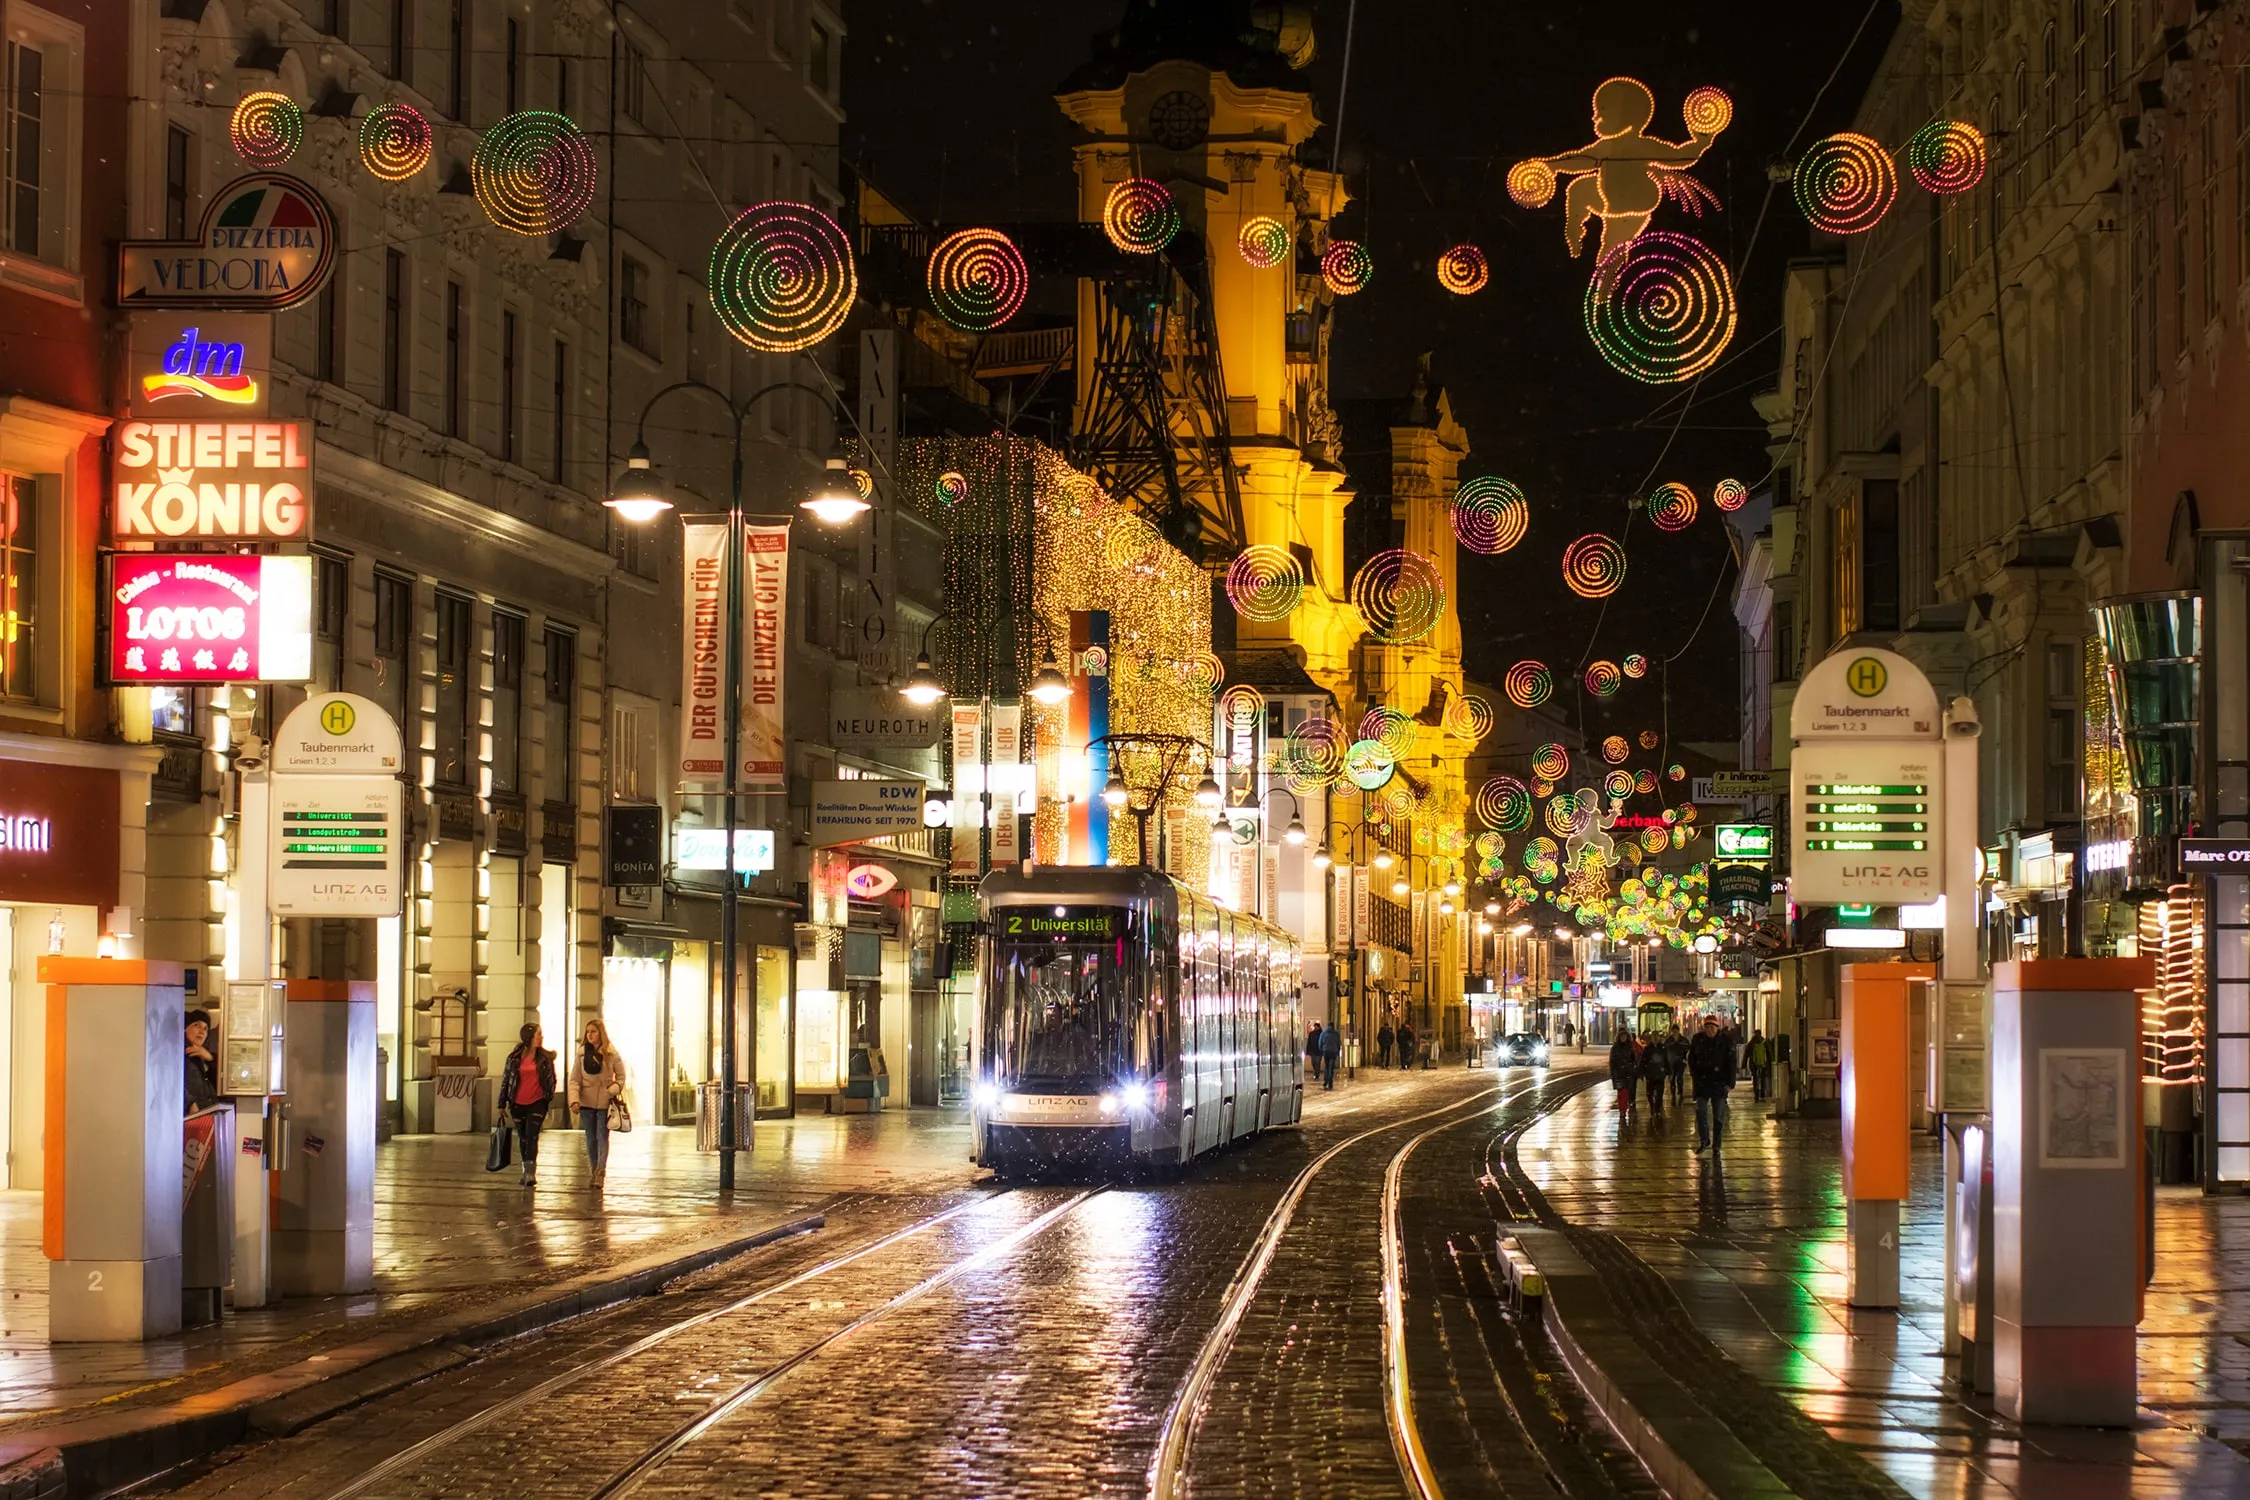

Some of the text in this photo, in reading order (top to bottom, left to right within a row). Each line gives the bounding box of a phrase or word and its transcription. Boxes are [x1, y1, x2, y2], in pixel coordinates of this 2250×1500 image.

[213, 228, 314, 249] PIZZERIA
[153, 258, 289, 291] VERONA
[162, 327, 244, 376] dm
[119, 423, 308, 468] STIEFEL
[754, 559, 779, 603] CITY.
[126, 606, 245, 640] LOTOS
[690, 557, 719, 739] DER GUTSCHEIN FÜR
[753, 608, 777, 670] LINZER
[1858, 665, 1876, 689] H
[753, 676, 776, 705] DIE
[330, 707, 346, 728] H
[1823, 705, 1910, 717] Taubenmarkt
[837, 719, 929, 734] NEUROTH
[1811, 722, 1839, 731] Linien
[300, 741, 375, 753] Taubenmarkt
[289, 757, 313, 765] Linien
[880, 787, 918, 798] RDW
[817, 803, 917, 812] Realitäten Dienst Winkler
[816, 816, 917, 825] ERFAHRUNG SEIT 1970
[2184, 850, 2226, 862] Marc
[1897, 866, 1929, 877] AG
[360, 884, 387, 894] AG
[1720, 884, 1757, 895] TRACHTEN
[1007, 916, 1110, 934] 2 Universität
[1066, 1098, 1089, 1106] AG
[1878, 1231, 1894, 1250] 4
[87, 1270, 104, 1291] 2
